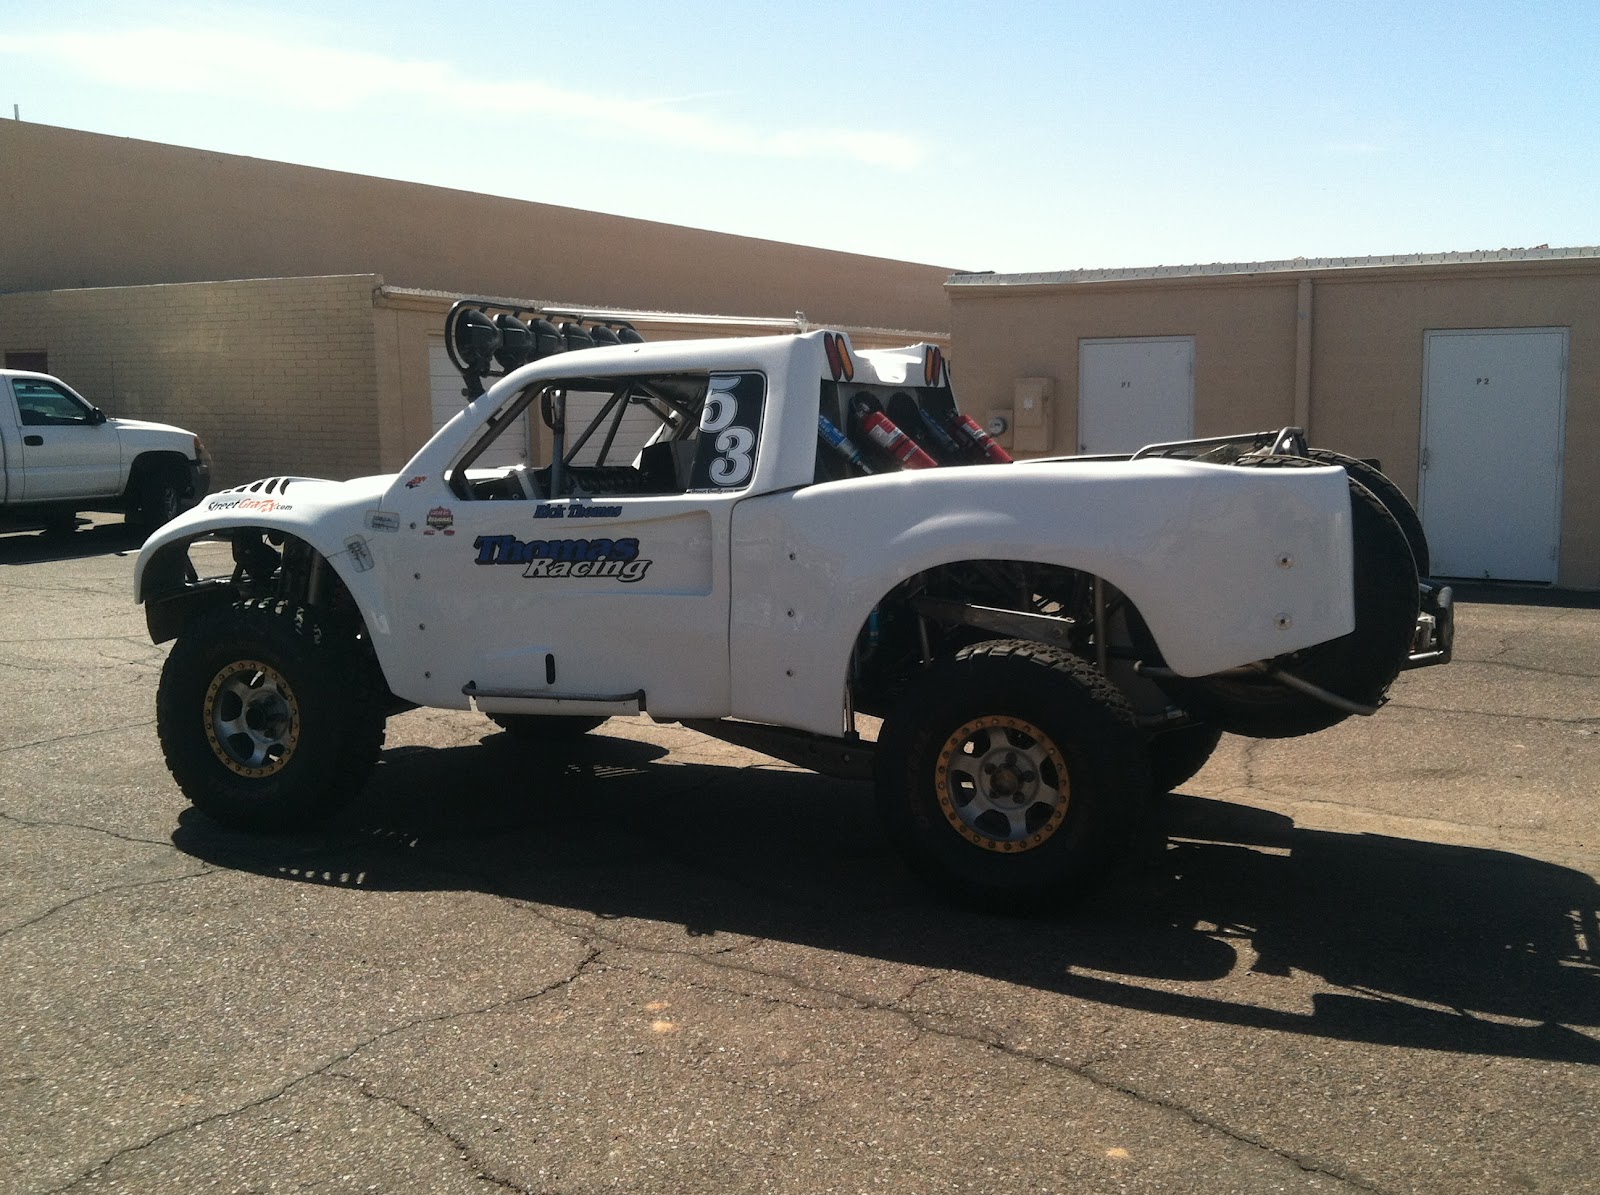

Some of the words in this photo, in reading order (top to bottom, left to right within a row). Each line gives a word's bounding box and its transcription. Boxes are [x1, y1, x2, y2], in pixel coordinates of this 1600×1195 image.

[567, 504, 622, 518] Thomas
[473, 535, 640, 565] Thomas
[522, 556, 653, 583] Racing
